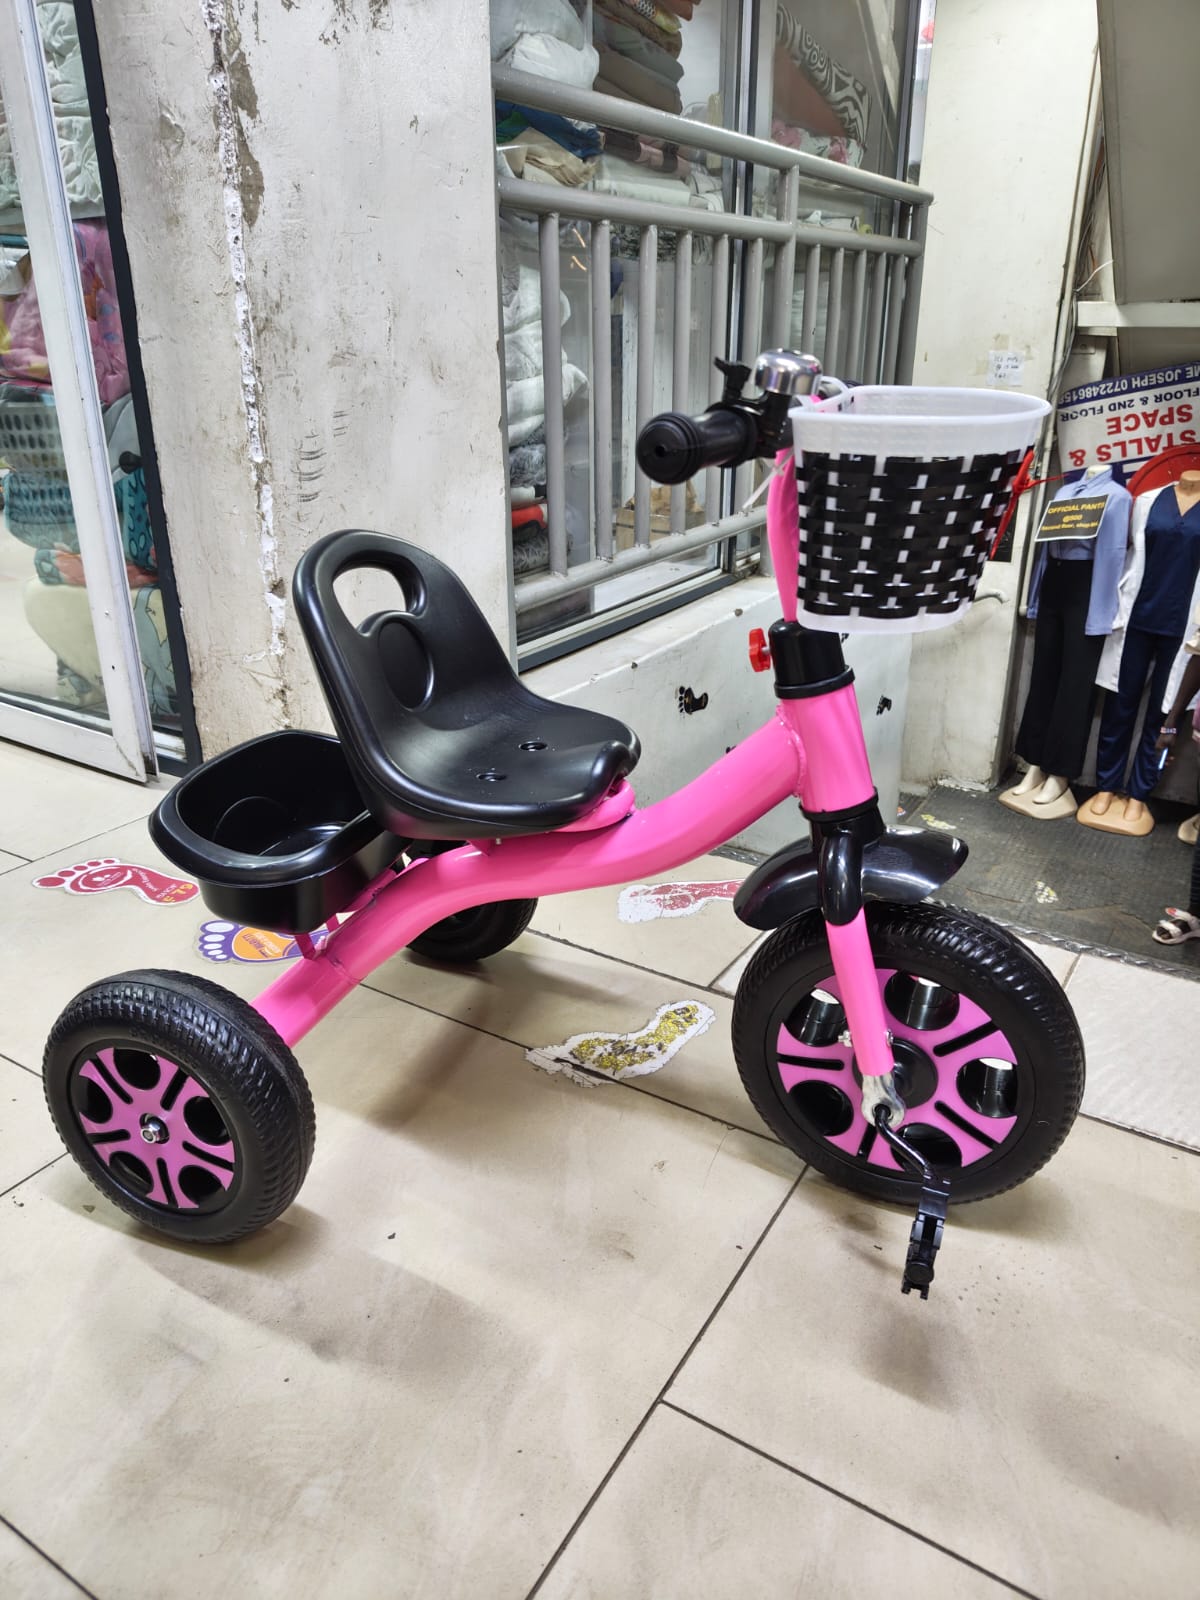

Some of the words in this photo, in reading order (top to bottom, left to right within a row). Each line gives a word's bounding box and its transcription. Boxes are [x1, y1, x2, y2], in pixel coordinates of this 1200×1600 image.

[1132, 369, 1181, 388] JOSEPH
[1140, 396, 1149, 405] &
[1154, 387, 1200, 403] FLOOR
[1060, 405, 1103, 422] FLOOR
[1108, 399, 1135, 412] 2ND
[1106, 404, 1193, 436] SPACE
[1096, 430, 1196, 462] STALLS
[1068, 449, 1086, 467] &
[1048, 504, 1079, 514] OFFICIAL
